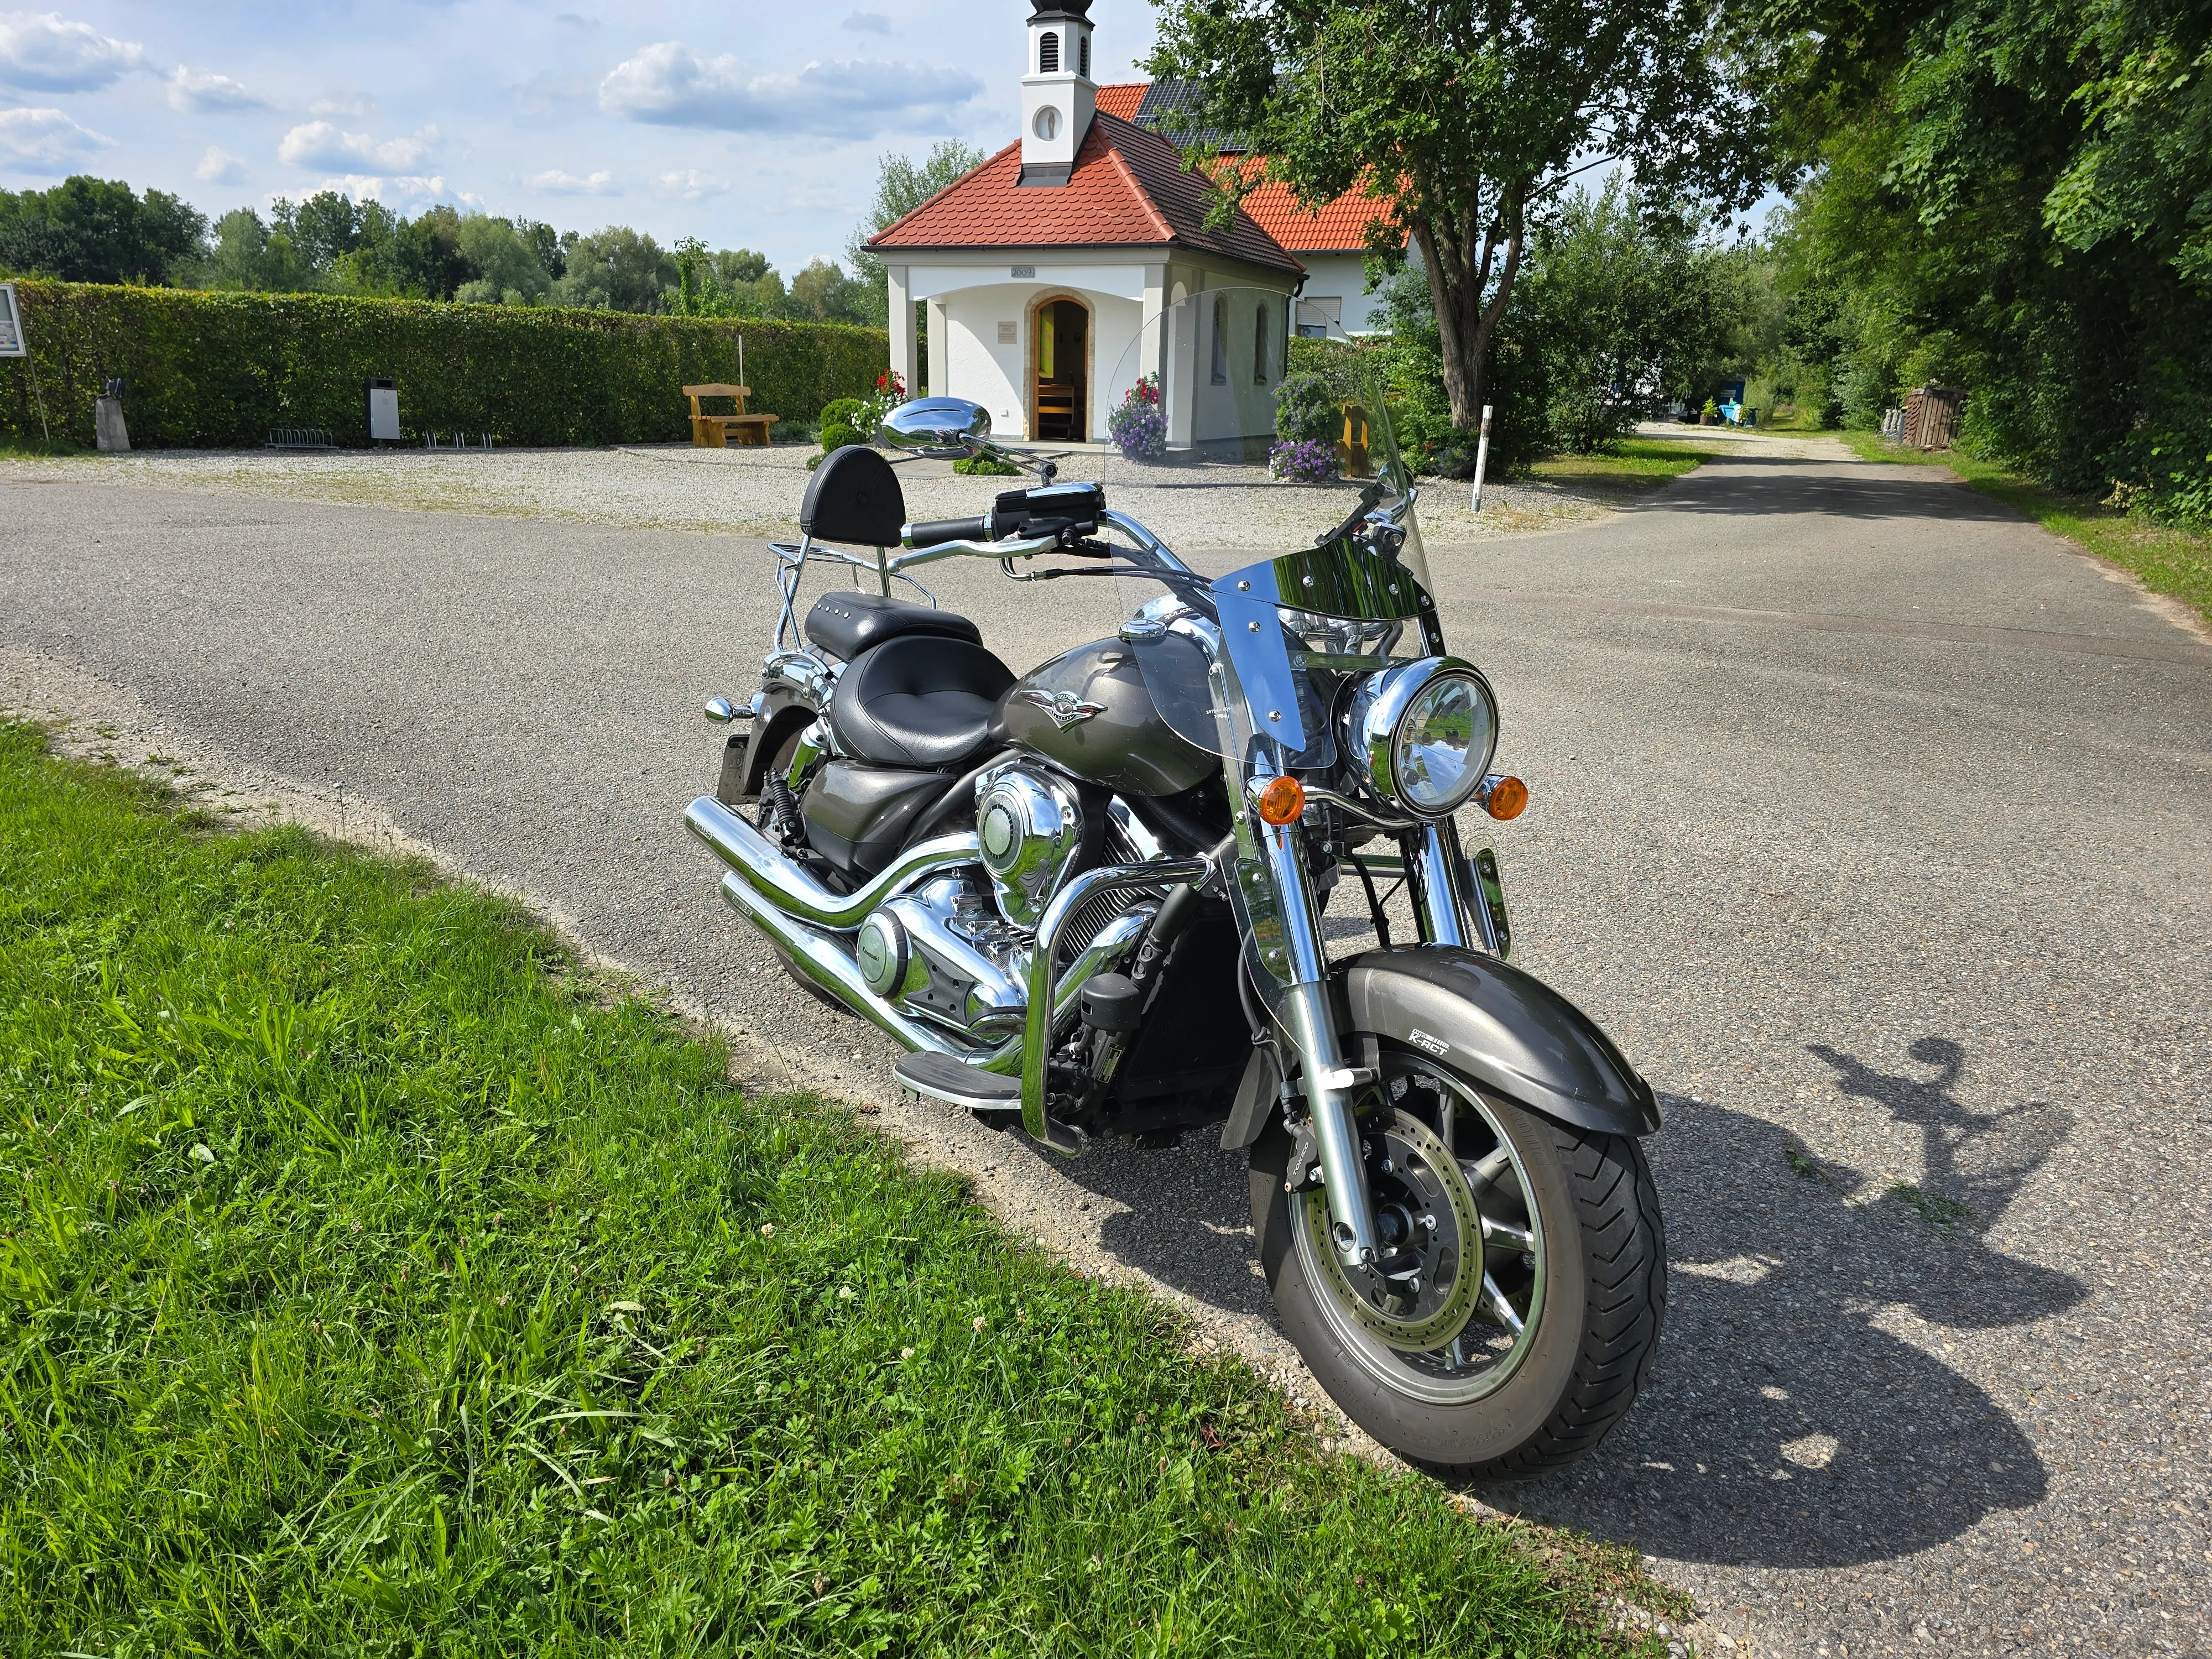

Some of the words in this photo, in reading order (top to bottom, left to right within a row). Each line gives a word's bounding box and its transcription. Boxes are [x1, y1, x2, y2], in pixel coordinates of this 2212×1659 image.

[862, 946, 880, 962] Kawasaki
[1408, 1032, 1447, 1056] K-ACT
[1293, 1141, 1309, 1176] TOKICO
